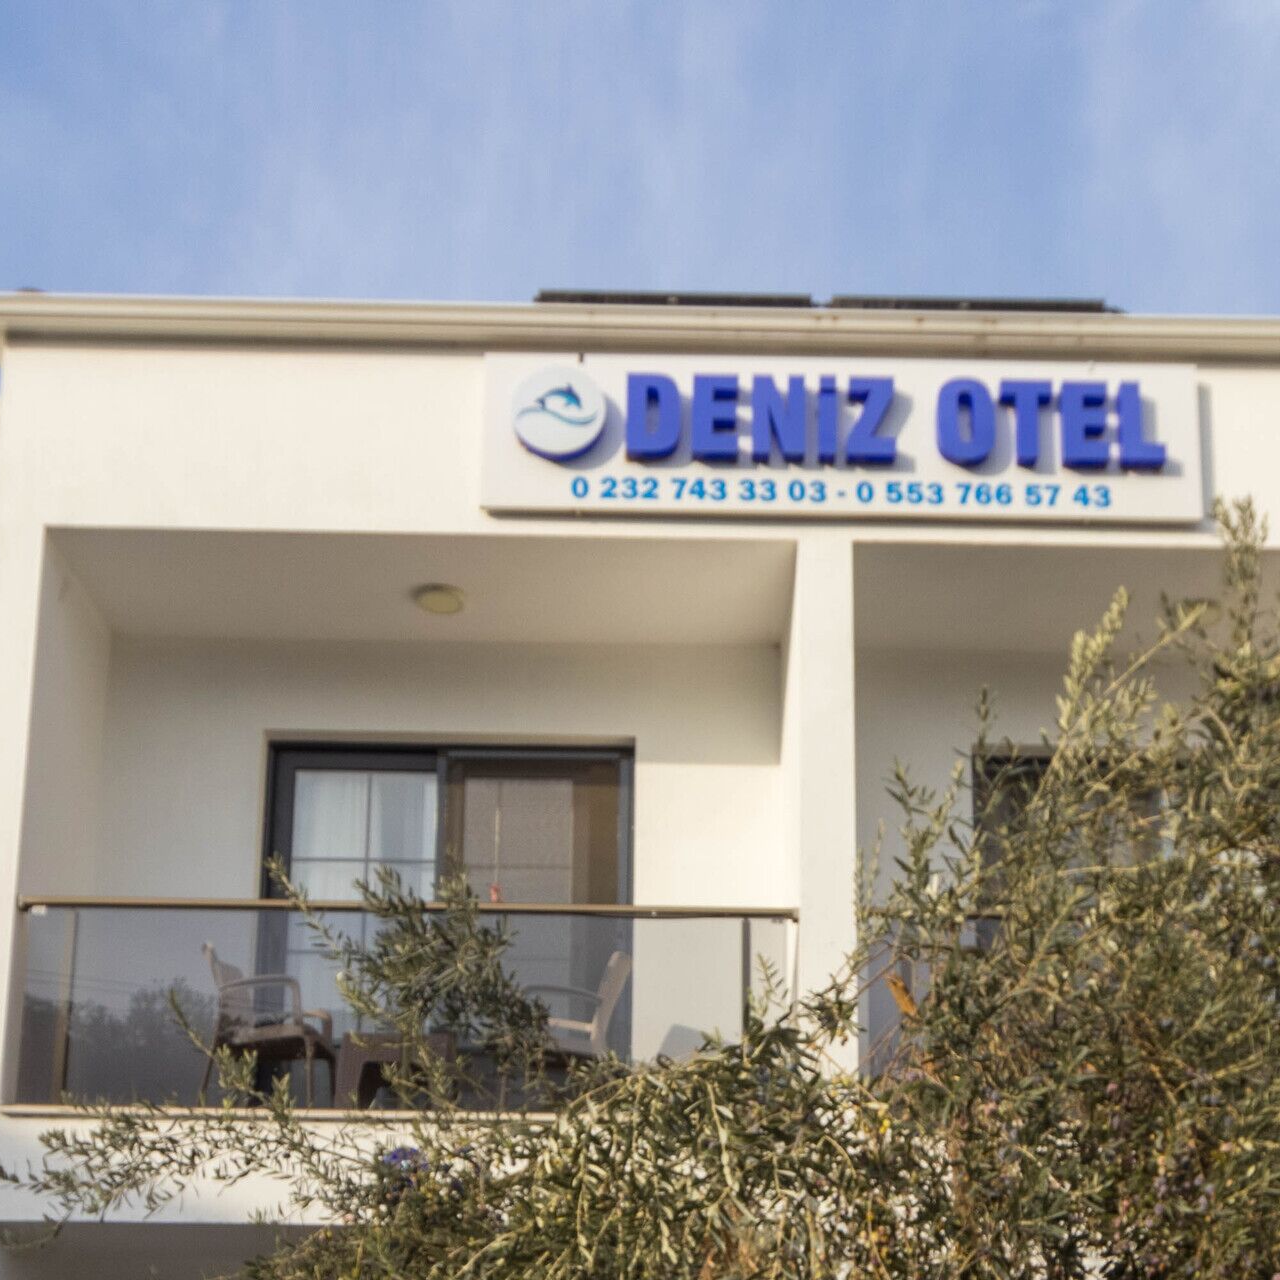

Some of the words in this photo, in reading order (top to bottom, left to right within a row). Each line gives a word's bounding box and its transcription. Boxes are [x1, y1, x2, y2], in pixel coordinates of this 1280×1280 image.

[936, 379, 1167, 468] OTEL
[571, 477, 590, 499] 0
[600, 477, 658, 500] 232
[671, 478, 727, 502] 743
[739, 479, 777, 502] 33
[787, 480, 826, 503] 03
[856, 481, 874, 504] 0
[885, 481, 943, 505] 553
[956, 482, 1013, 506] 766
[1024, 483, 1061, 507] 57
[1073, 484, 1111, 508] 43
